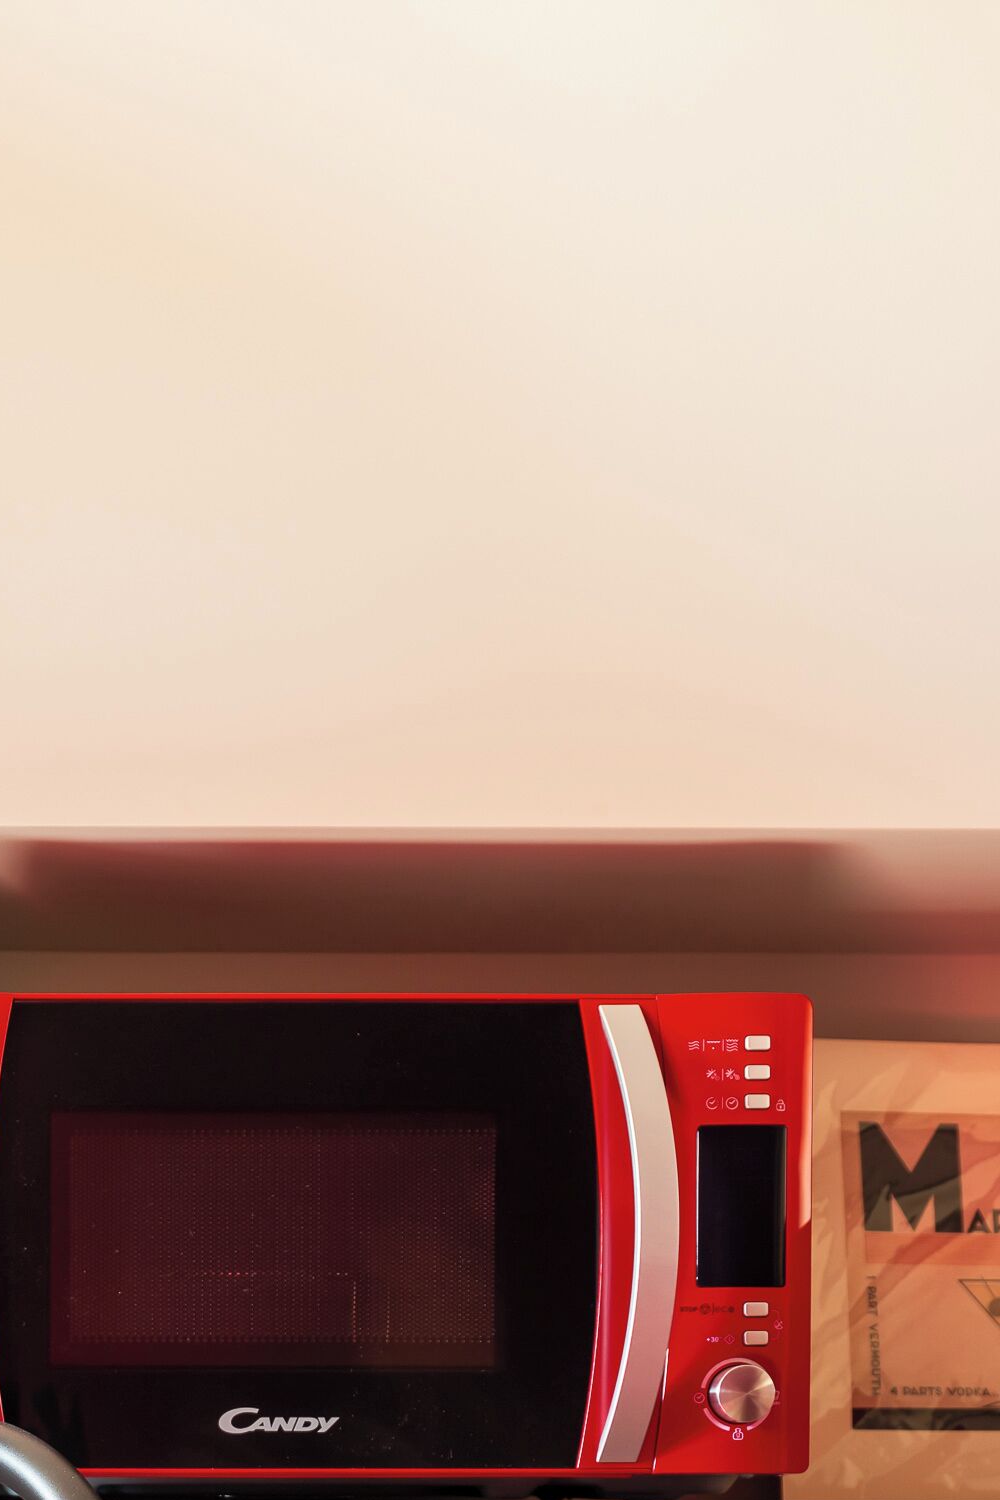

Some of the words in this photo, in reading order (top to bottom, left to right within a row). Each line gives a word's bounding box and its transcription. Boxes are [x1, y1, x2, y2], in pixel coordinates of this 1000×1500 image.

[867, 1286, 879, 1317] PART
[869, 1322, 882, 1397] VERMOUTH
[890, 1386, 899, 1396] 4
[902, 1386, 943, 1396] PARTS
